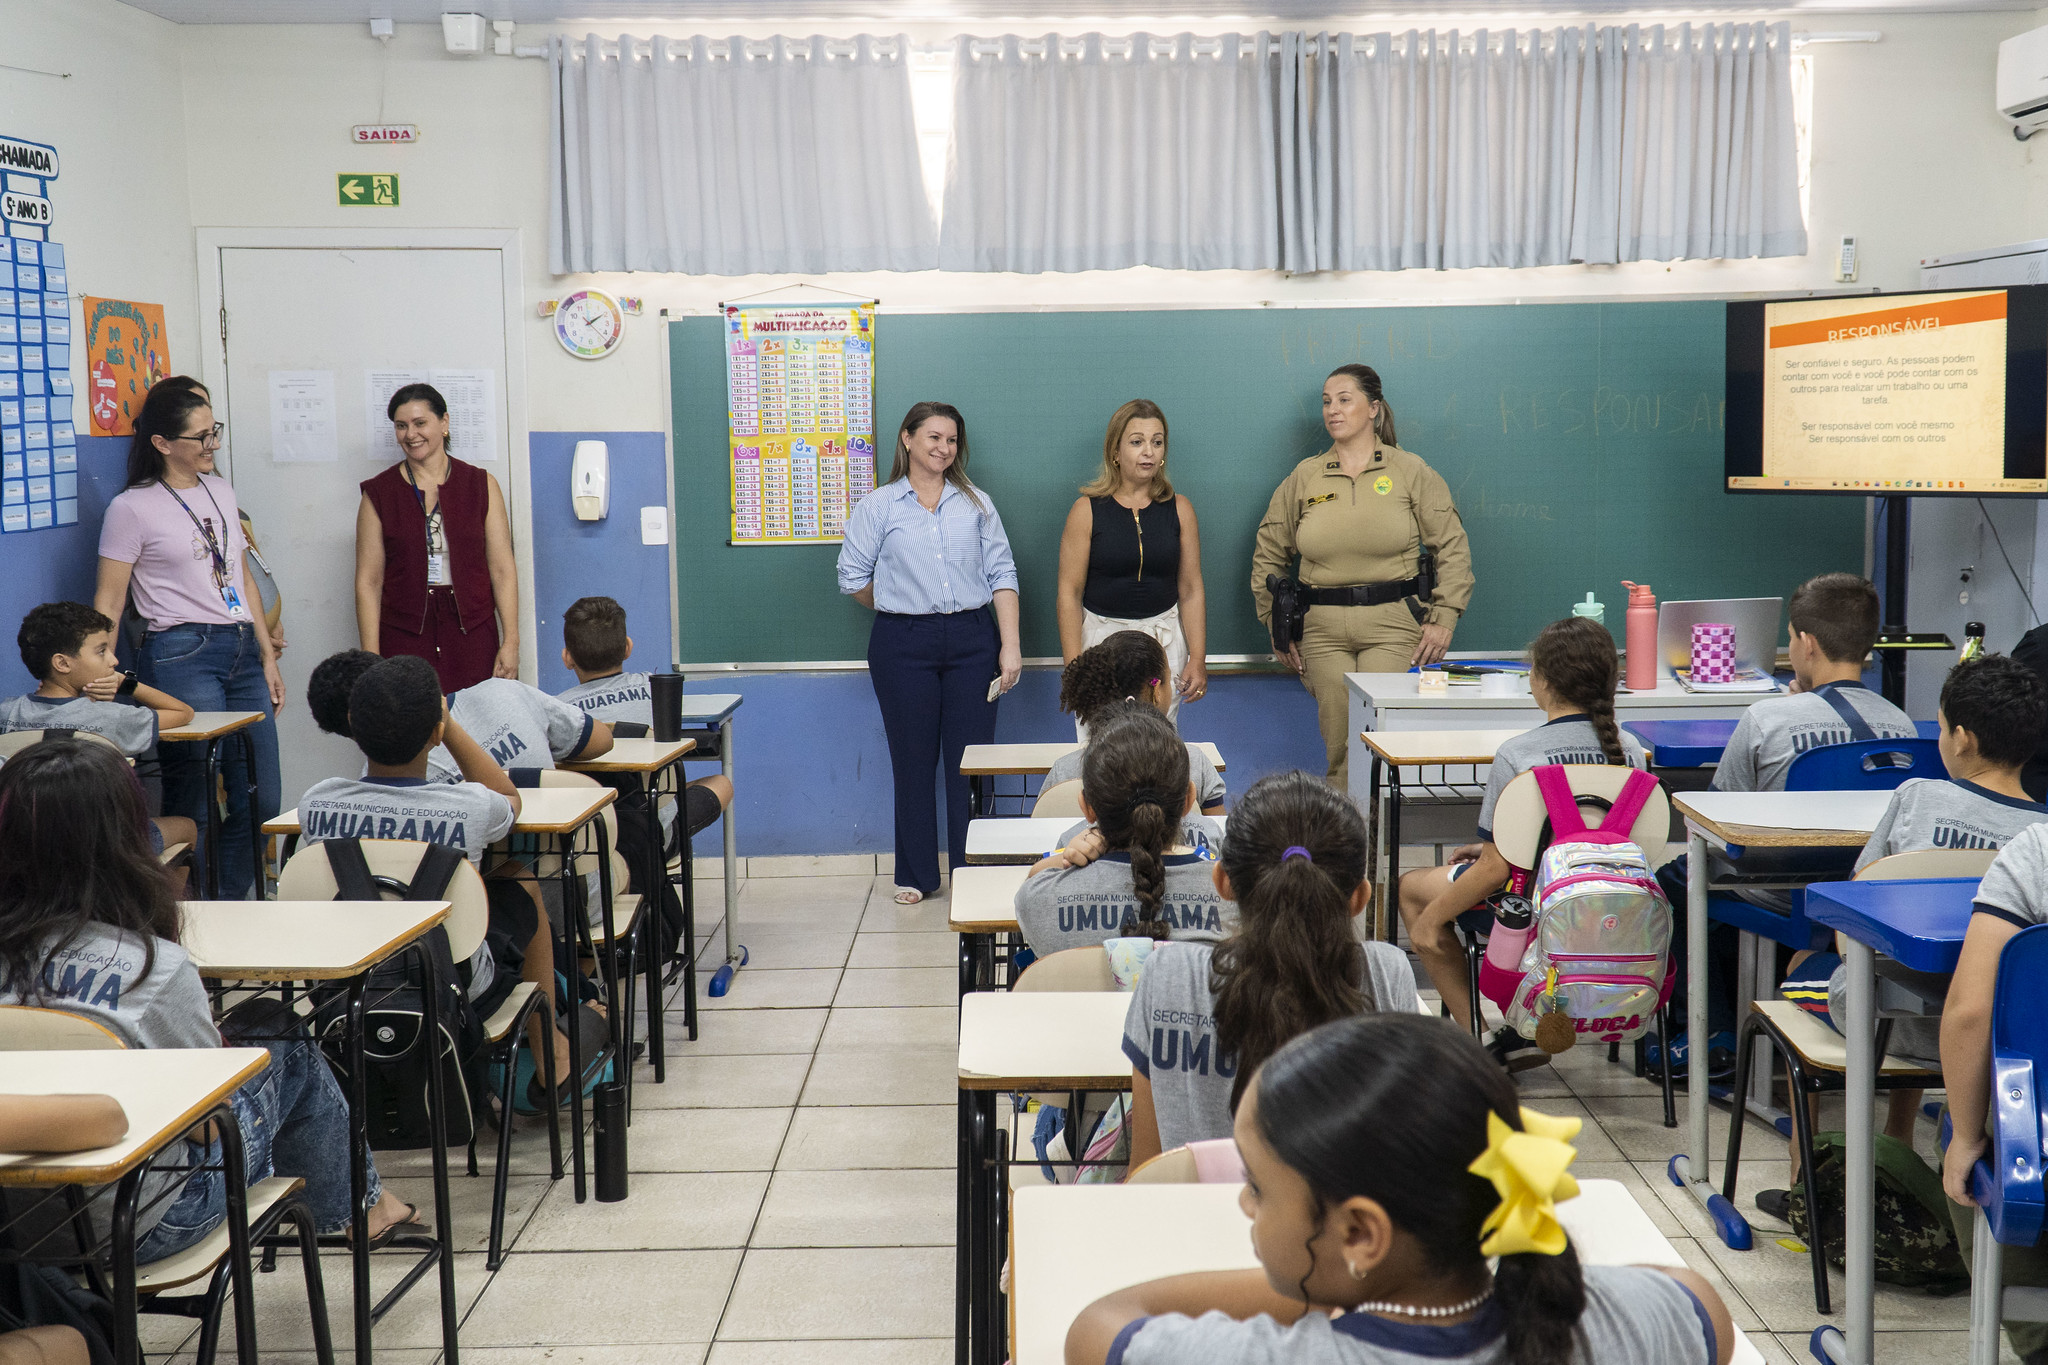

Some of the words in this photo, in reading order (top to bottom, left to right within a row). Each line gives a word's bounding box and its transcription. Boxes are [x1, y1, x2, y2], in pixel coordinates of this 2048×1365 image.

[359, 129, 411, 140] SAÍDA
[17, 199, 38, 220] ANO
[41, 203, 48, 220] B
[753, 317, 848, 333] MULTIPLICAÇÃO
[1828, 317, 1940, 343] RESPONSÁVEL
[1786, 360, 1800, 368] Ser
[1803, 359, 1841, 368] confiável
[1887, 357, 1899, 365] As
[1901, 356, 1939, 366] pessoas
[1942, 355, 1975, 364] podem
[1782, 373, 1808, 381] contar
[1832, 371, 1852, 380] você
[1863, 370, 1884, 379] você
[1887, 370, 1910, 379] pode
[1912, 369, 1941, 377] contar
[1790, 385, 1817, 393] outros
[1819, 385, 1839, 394] para
[1841, 383, 1874, 392] realizar
[1893, 381, 1930, 391] trabalho
[1802, 422, 1817, 430] Ser
[1819, 421, 1872, 431] responsável
[1896, 421, 1918, 429] você
[1826, 434, 1879, 444] responsável
[572, 687, 651, 711] MUARAMA
[1789, 722, 1837, 733] SECRETARIA
[309, 800, 351, 811] SECRETARIA
[353, 804, 399, 815] MUNICIPAL
[402, 808, 414, 816] DE
[417, 808, 468, 820] EDUCAÇÃO
[308, 810, 466, 848] UMUARAMA
[1935, 818, 1980, 834] SECRETARIA
[1057, 894, 1109, 905] SECRETARIA
[1173, 893, 1220, 904] EDUCAÇÃO
[1058, 903, 1222, 933] UMUAAMA
[1153, 1010, 1218, 1029] SECRETAR
